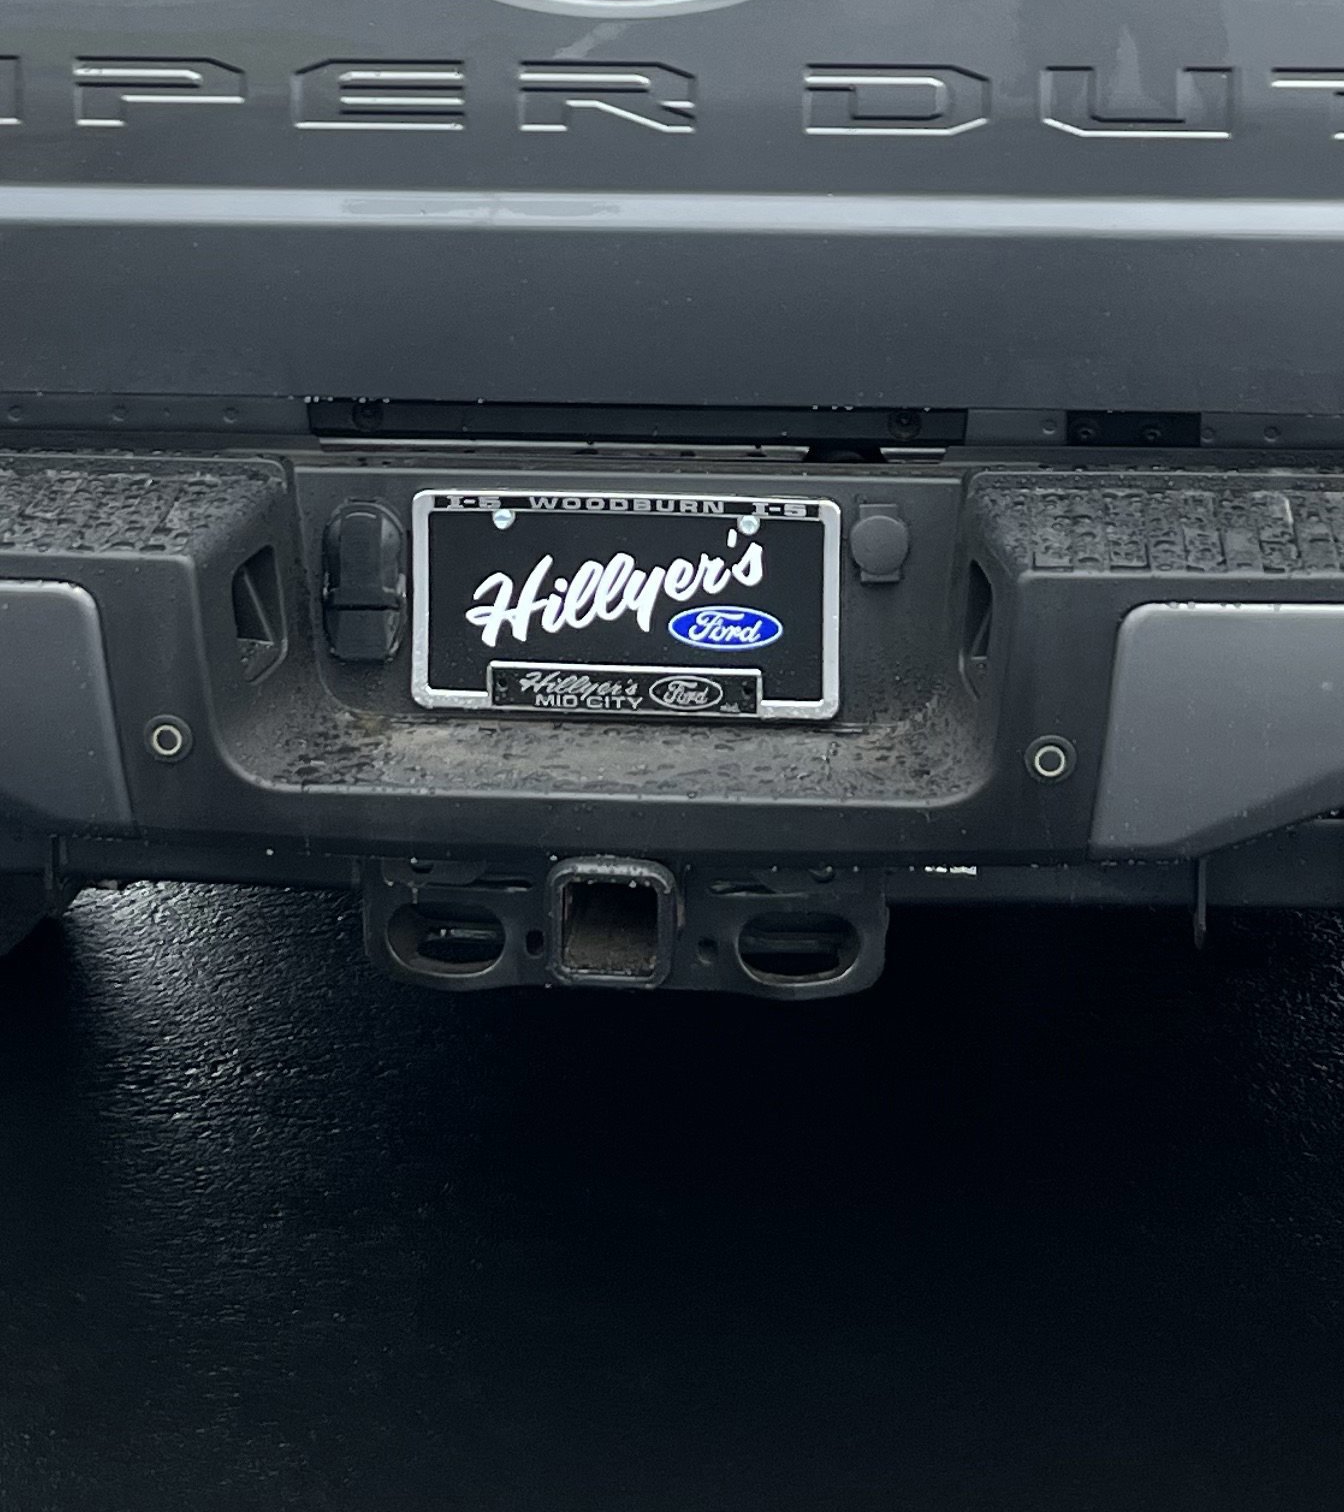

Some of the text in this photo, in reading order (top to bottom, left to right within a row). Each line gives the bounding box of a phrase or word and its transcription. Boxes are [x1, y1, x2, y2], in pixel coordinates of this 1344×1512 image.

[446, 496, 808, 518] I-5 WOODBURN I-5
[465, 528, 764, 648] Hillyer's
[687, 610, 761, 645] Ford
[519, 671, 640, 701] Hillyer's
[662, 679, 709, 706] Ford
[535, 694, 644, 711] MID CITY
